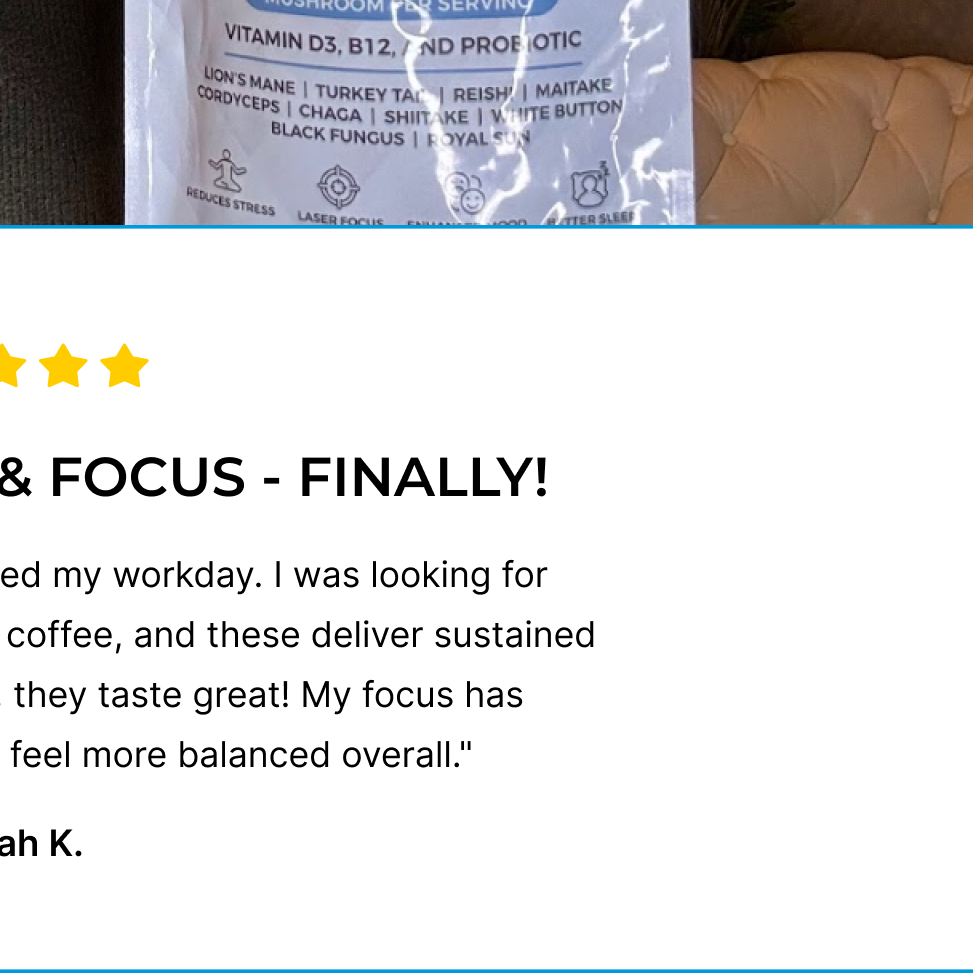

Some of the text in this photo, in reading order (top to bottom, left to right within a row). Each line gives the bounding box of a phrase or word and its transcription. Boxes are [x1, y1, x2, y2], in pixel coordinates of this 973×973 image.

[225, 22, 303, 50] VITAMIN
[309, 34, 342, 56] D3,
[348, 37, 396, 58] B12,
[204, 65, 246, 87] LION'S
[249, 75, 296, 96] MANE
[316, 83, 387, 103] TURKEY
[535, 77, 612, 99] MAITAKE
[197, 84, 281, 114] CORDYCEPS
[299, 104, 363, 123] CHAGA
[384, 110, 469, 126] SHIITAKE
[554, 98, 624, 119] BUTTON
[271, 121, 326, 141] BLACK
[330, 128, 405, 146] FUNGUS
[186, 185, 276, 217] REDUCES STRESS
[297, 209, 337, 225] LASER
